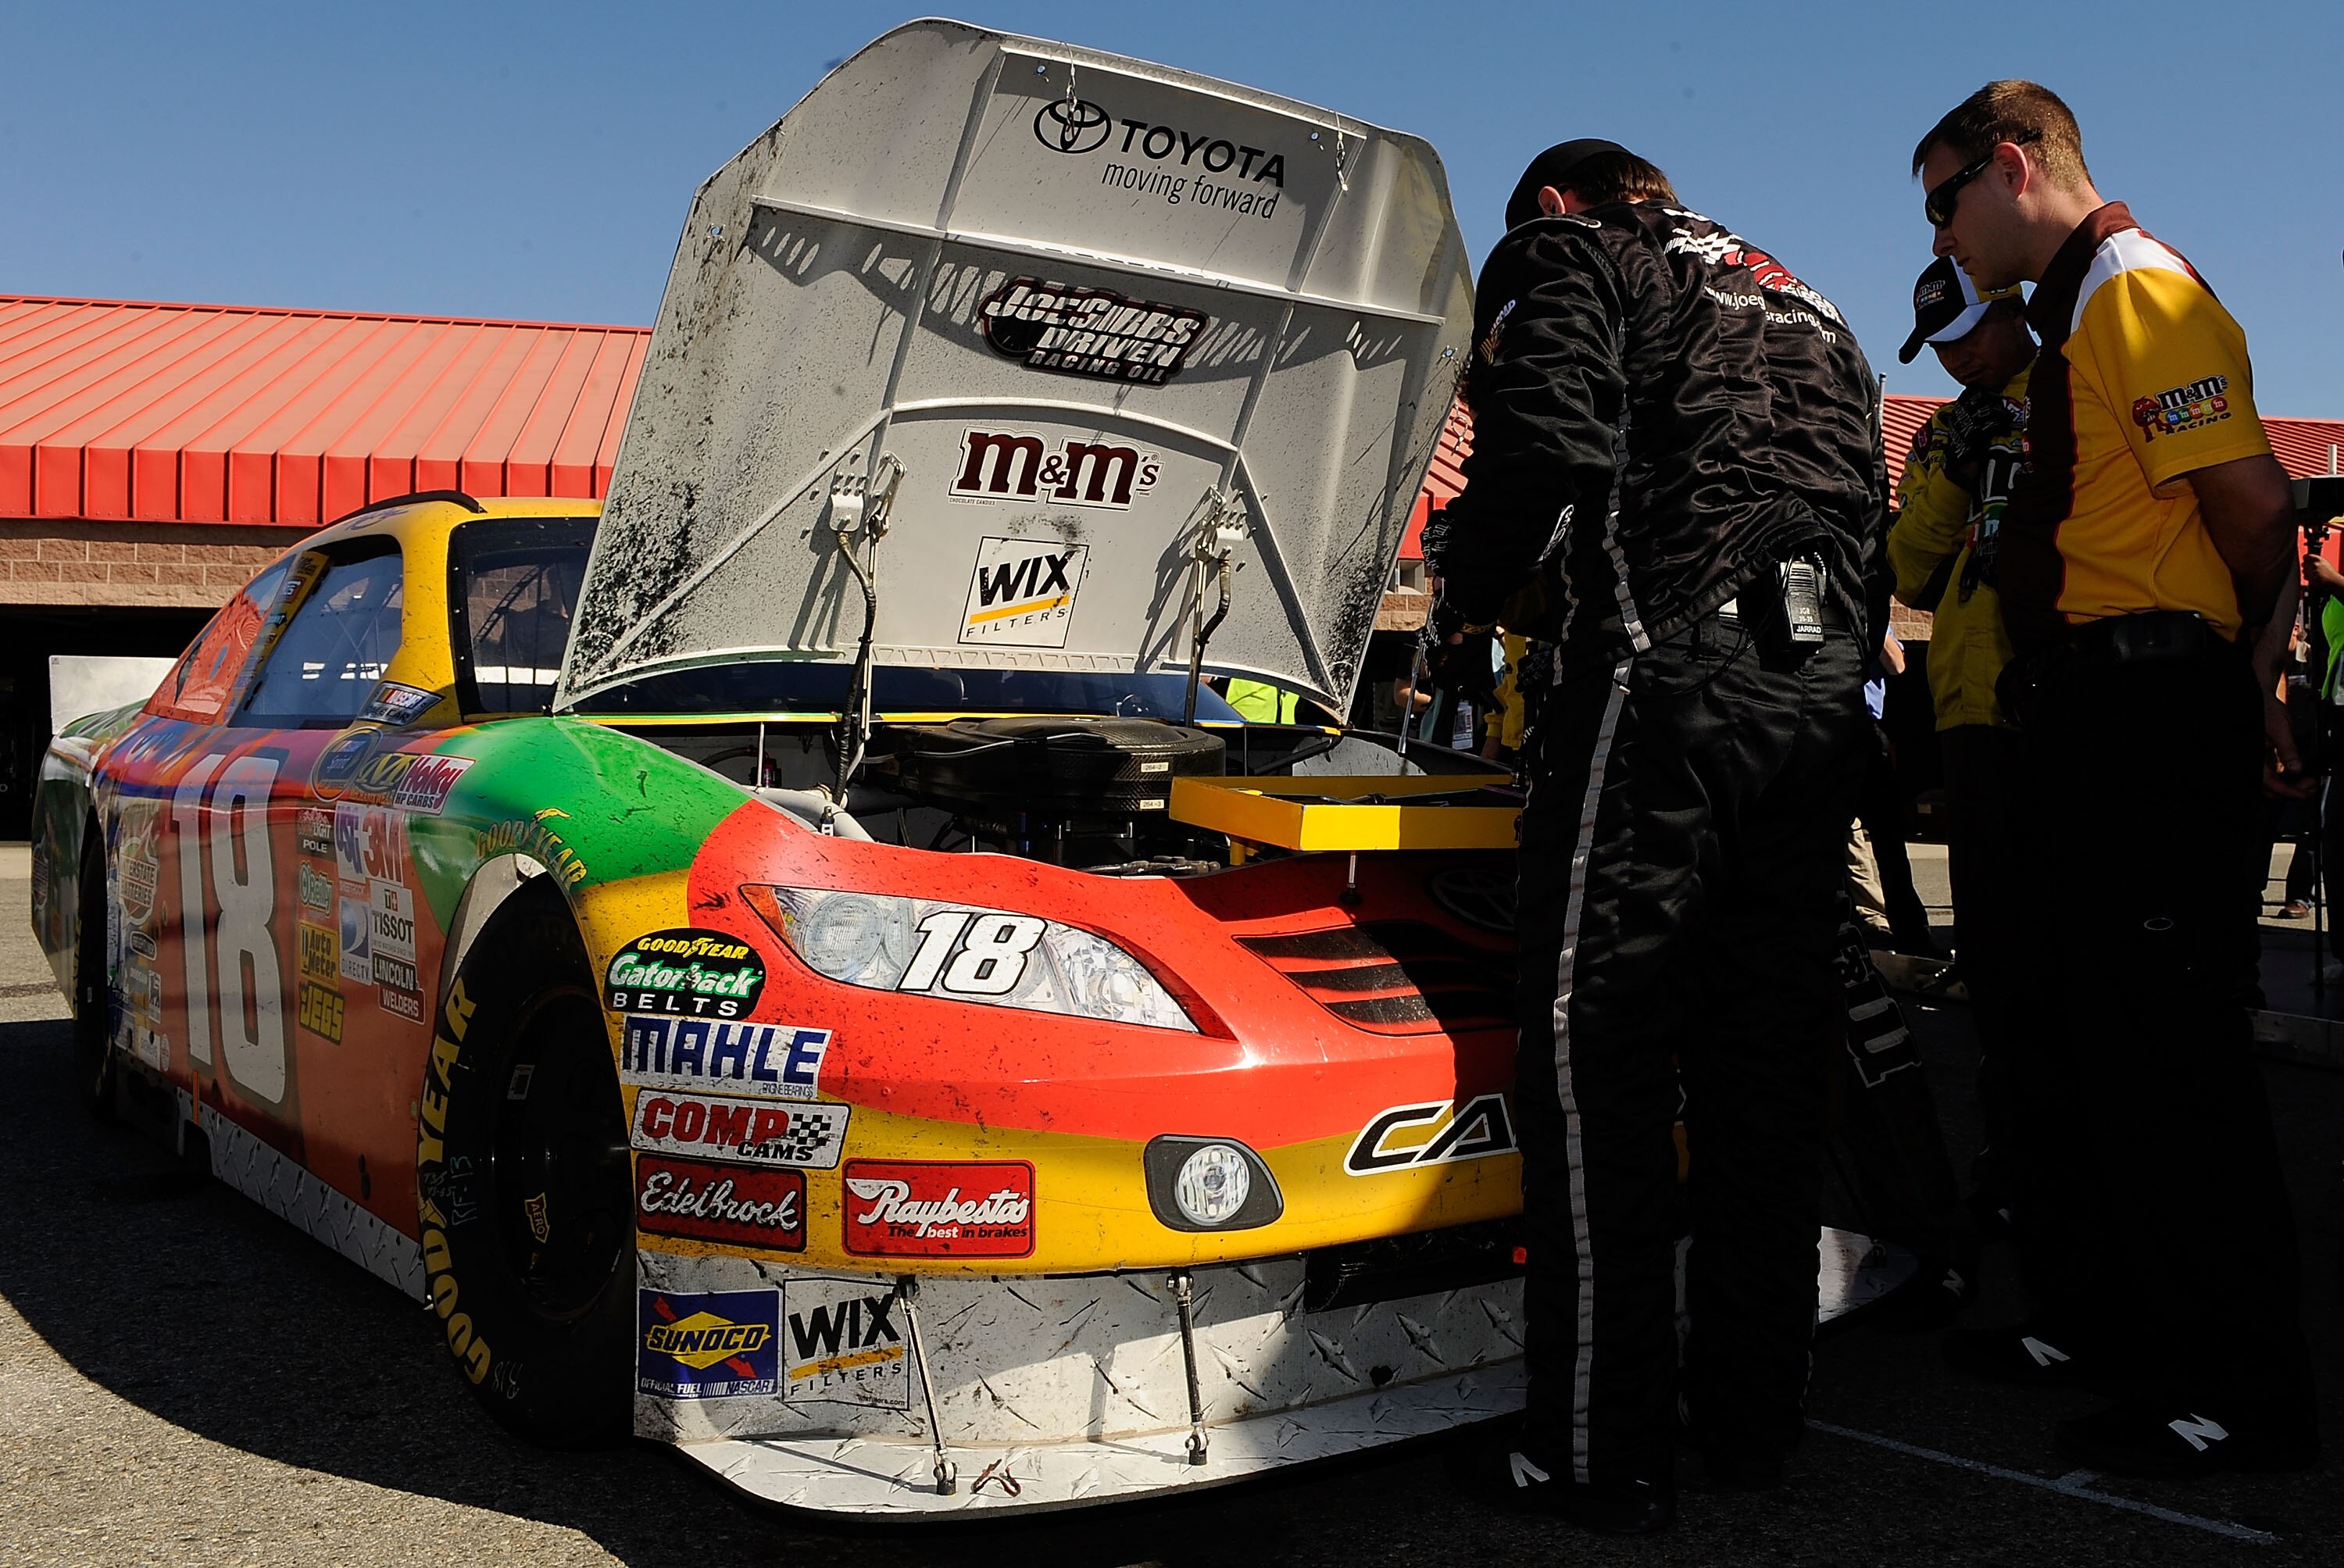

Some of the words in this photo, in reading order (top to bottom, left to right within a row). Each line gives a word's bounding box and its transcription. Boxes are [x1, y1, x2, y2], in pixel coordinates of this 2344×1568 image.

[1120, 118, 1285, 188] TOYOTA
[1101, 163, 1188, 205] moving
[1191, 174, 1281, 220] forward
[1036, 327, 1181, 367] DRIVEN
[1028, 350, 1121, 375] RACING
[1127, 364, 1167, 382] OIL
[2165, 412, 2232, 435] RACING
[978, 549, 1077, 608] WIX
[966, 608, 1068, 638] FILTERS
[1796, 625, 1821, 634] JARRAD
[385, 688, 424, 709] NASCAR
[386, 707, 410, 723] CAR
[398, 756, 464, 809] Holley
[395, 791, 406, 805] HP
[406, 794, 435, 809] CARBS
[302, 839, 328, 854] POLE
[172, 752, 283, 1104] 18
[309, 929, 332, 956] Auto
[372, 911, 414, 945] TISSOT
[897, 910, 1048, 995] 18
[374, 955, 414, 992] LINCOLN
[300, 983, 344, 1041] JEGS
[382, 988, 420, 1018] WELDERS
[613, 992, 739, 1016] BELTS
[621, 1016, 827, 1085] MAHLE
[642, 1098, 791, 1147] COMP
[737, 1141, 814, 1163] CAMS
[640, 1171, 799, 1230] Edelbrock
[846, 1178, 1031, 1238] Raybestos
[530, 1202, 546, 1238] AERO
[888, 1226, 914, 1238] The
[927, 1226, 959, 1238] best
[962, 1227, 975, 1238] in
[977, 1226, 1027, 1238] brakes
[649, 1326, 766, 1353] SUNOCO
[788, 1293, 901, 1360] WIX
[641, 1377, 674, 1392] OFFICIAL
[676, 1382, 702, 1395] FUEL
[726, 1380, 769, 1396] NASCAR
[790, 1362, 902, 1397] FILTERS
